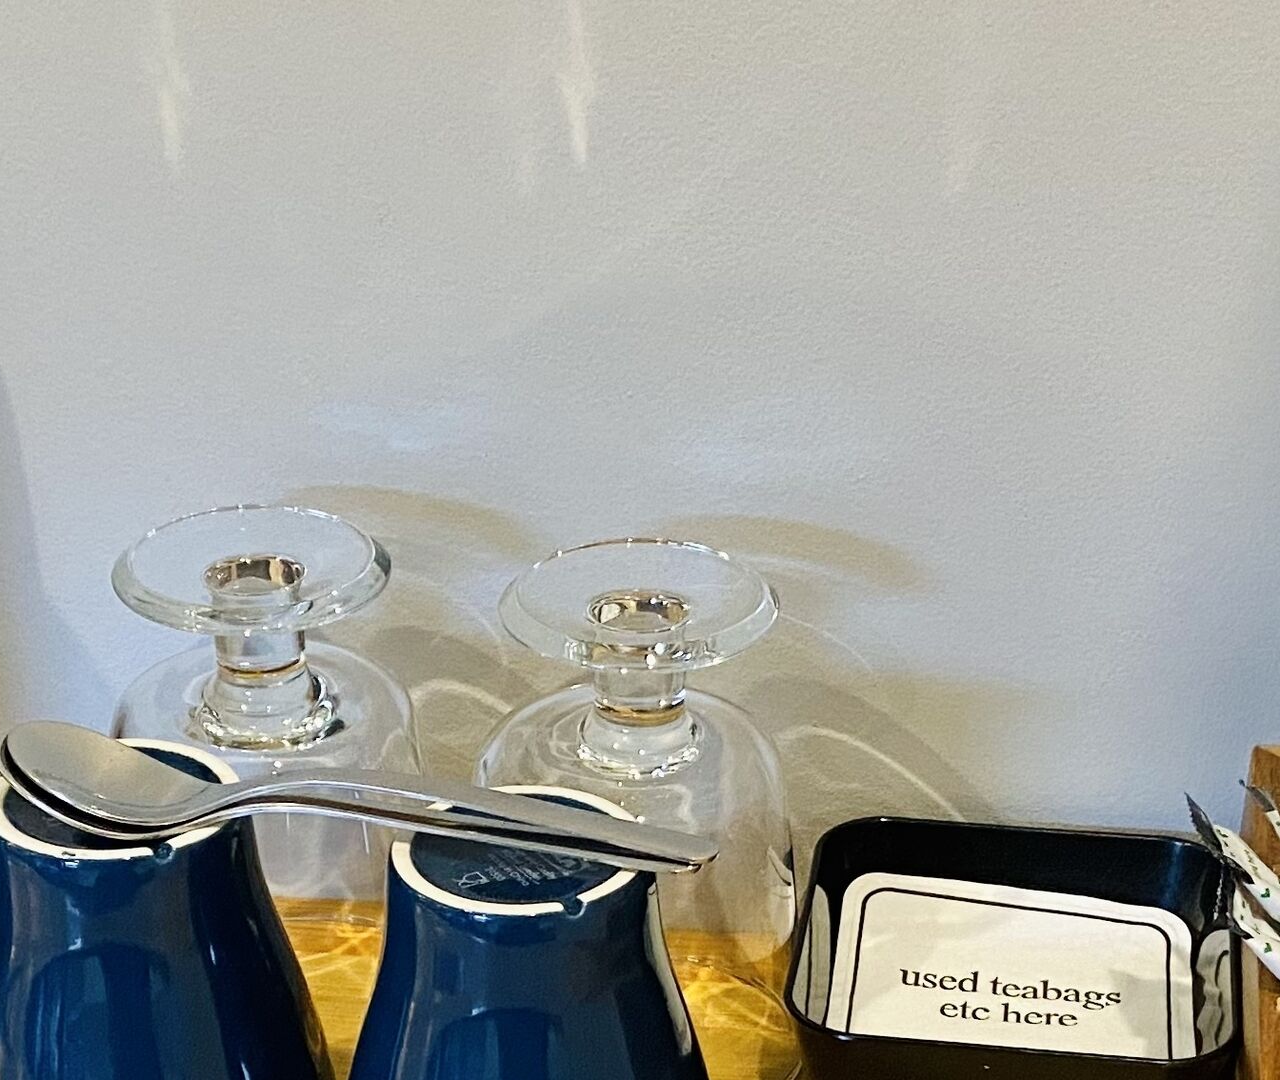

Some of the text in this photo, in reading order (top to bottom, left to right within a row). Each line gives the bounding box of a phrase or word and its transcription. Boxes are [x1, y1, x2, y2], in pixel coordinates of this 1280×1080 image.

[899, 968, 1122, 1011] used teabags
[939, 1000, 1078, 1027] etc here
